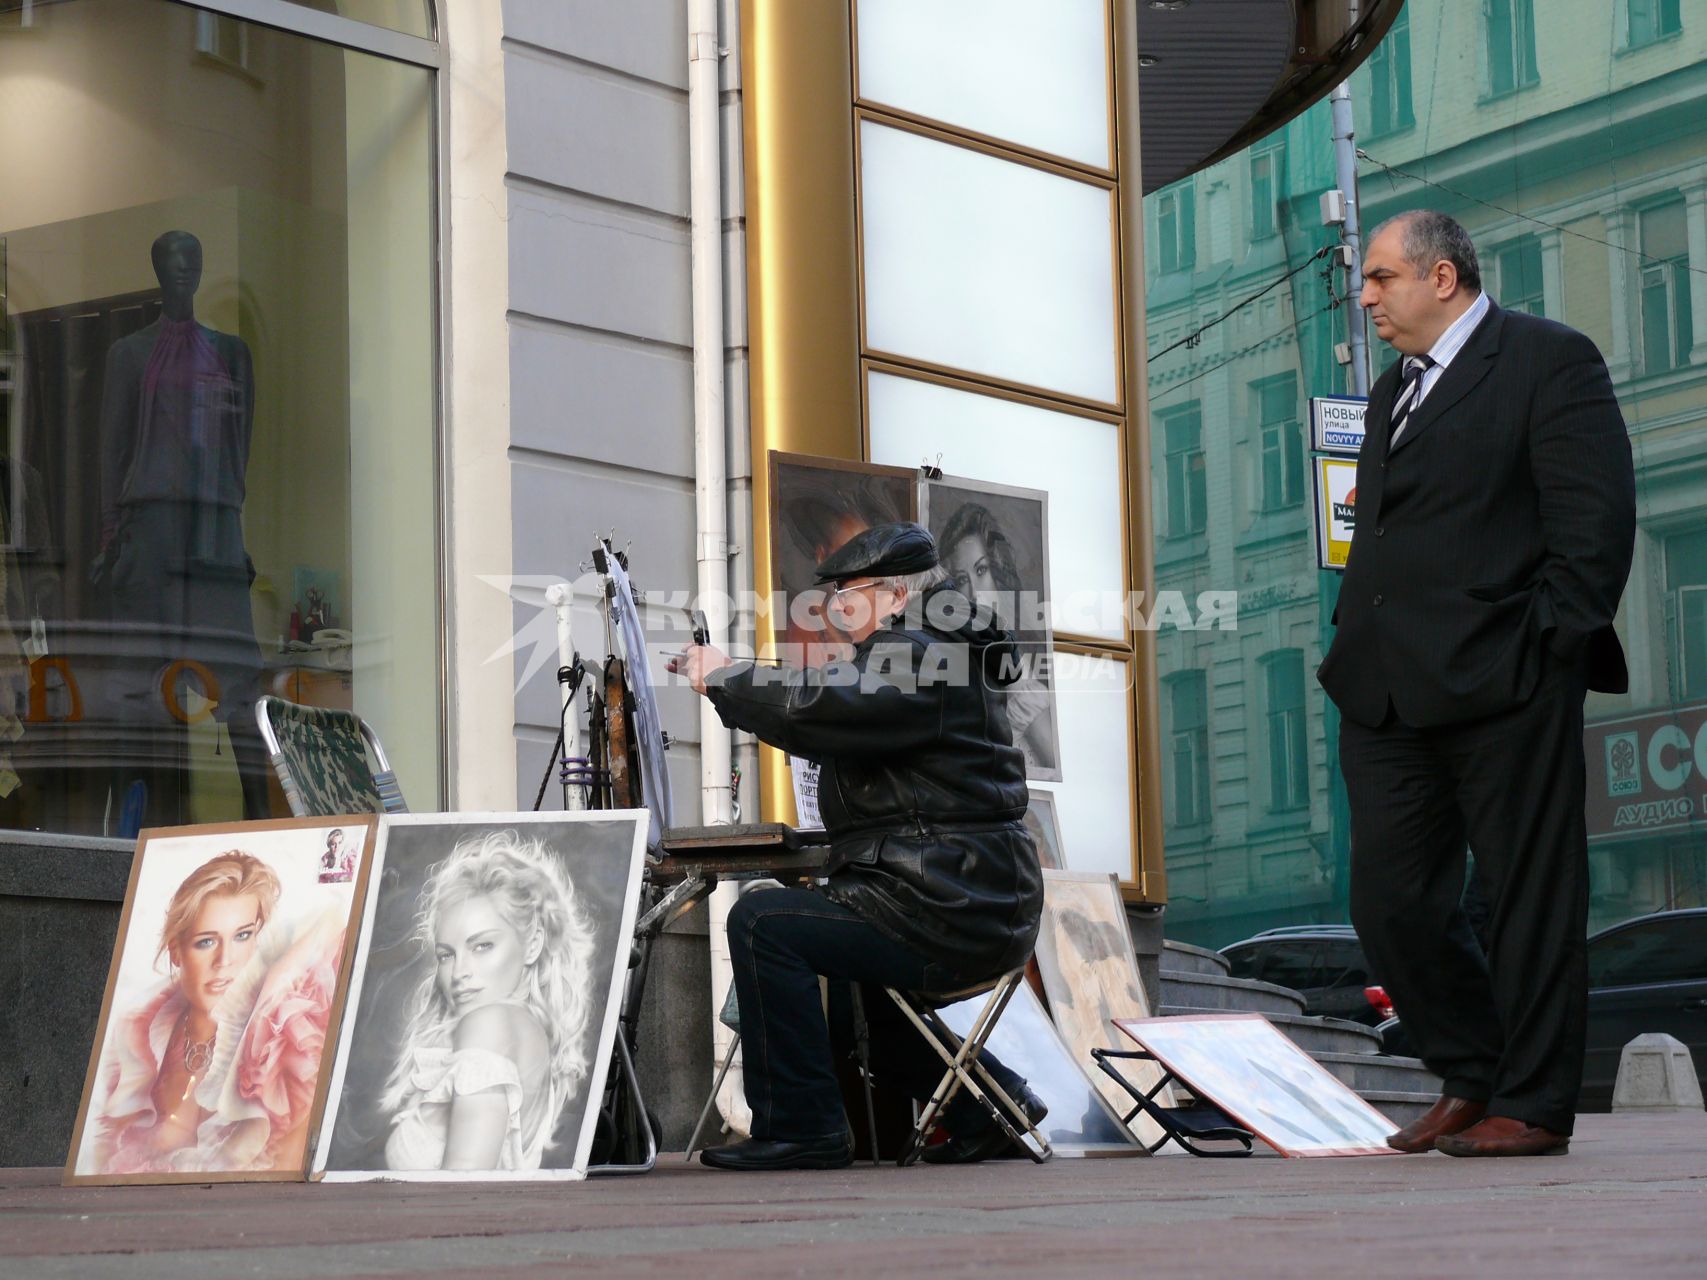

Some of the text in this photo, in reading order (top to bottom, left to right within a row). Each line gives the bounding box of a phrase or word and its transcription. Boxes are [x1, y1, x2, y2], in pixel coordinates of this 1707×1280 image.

[1325, 421, 1349, 429] улица
[1326, 433, 1355, 444] NOVYY
[1613, 797, 1694, 826] АУДИО
